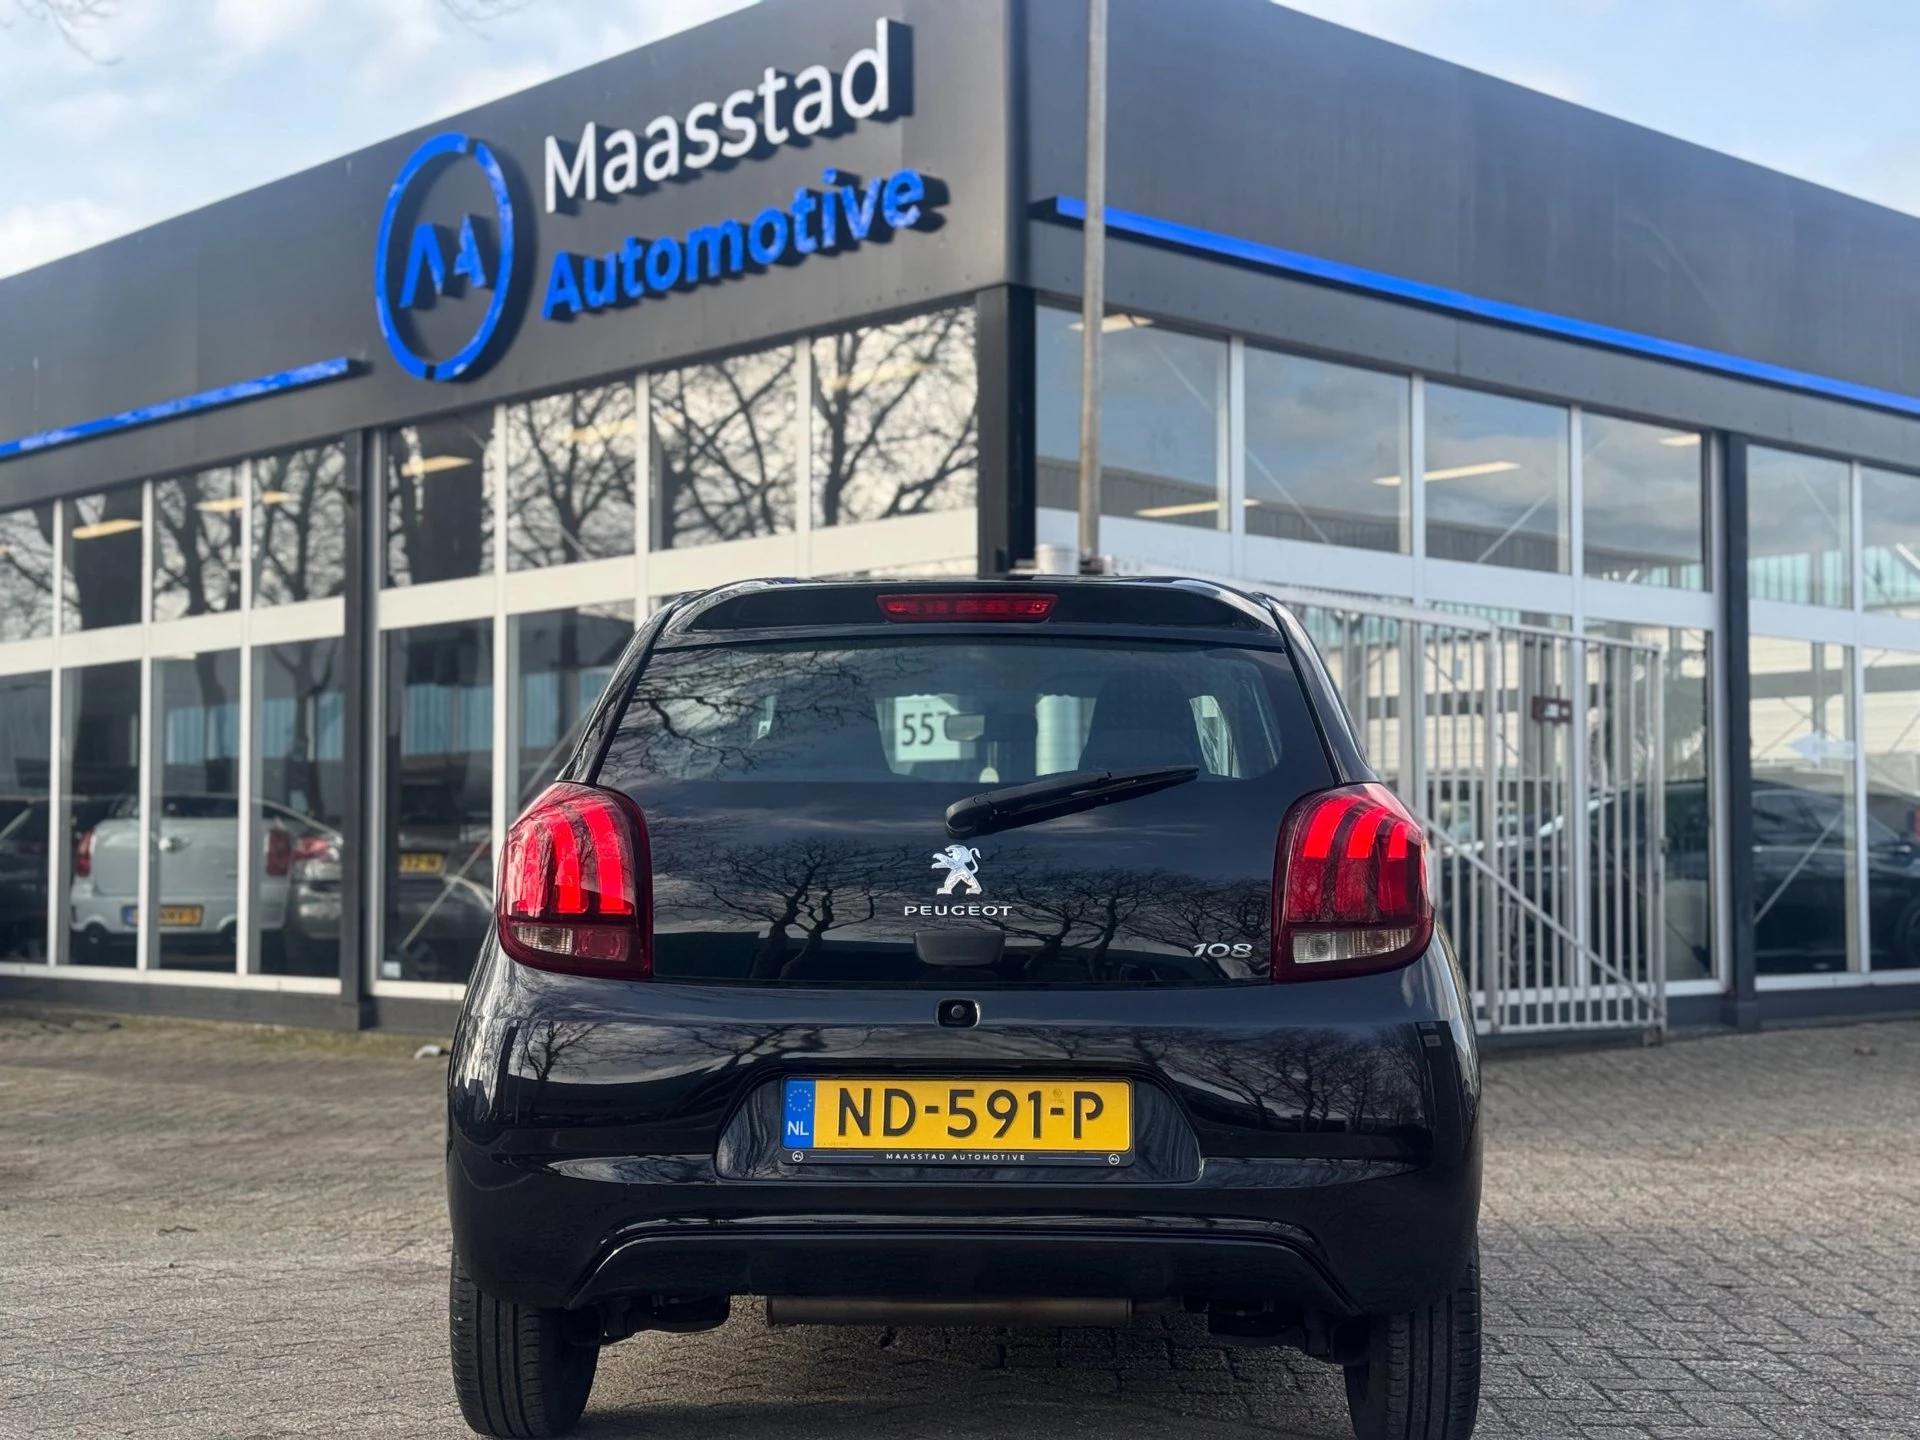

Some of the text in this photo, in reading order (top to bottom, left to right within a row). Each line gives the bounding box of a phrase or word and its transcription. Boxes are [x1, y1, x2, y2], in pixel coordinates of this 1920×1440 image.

[545, 16, 890, 213] Maasstad
[542, 167, 925, 320] Automotive
[904, 905, 1013, 916] PEUGEOT
[1193, 943, 1253, 958] 108
[787, 1121, 810, 1136] NL
[838, 1088, 1104, 1139] ND-591-P
